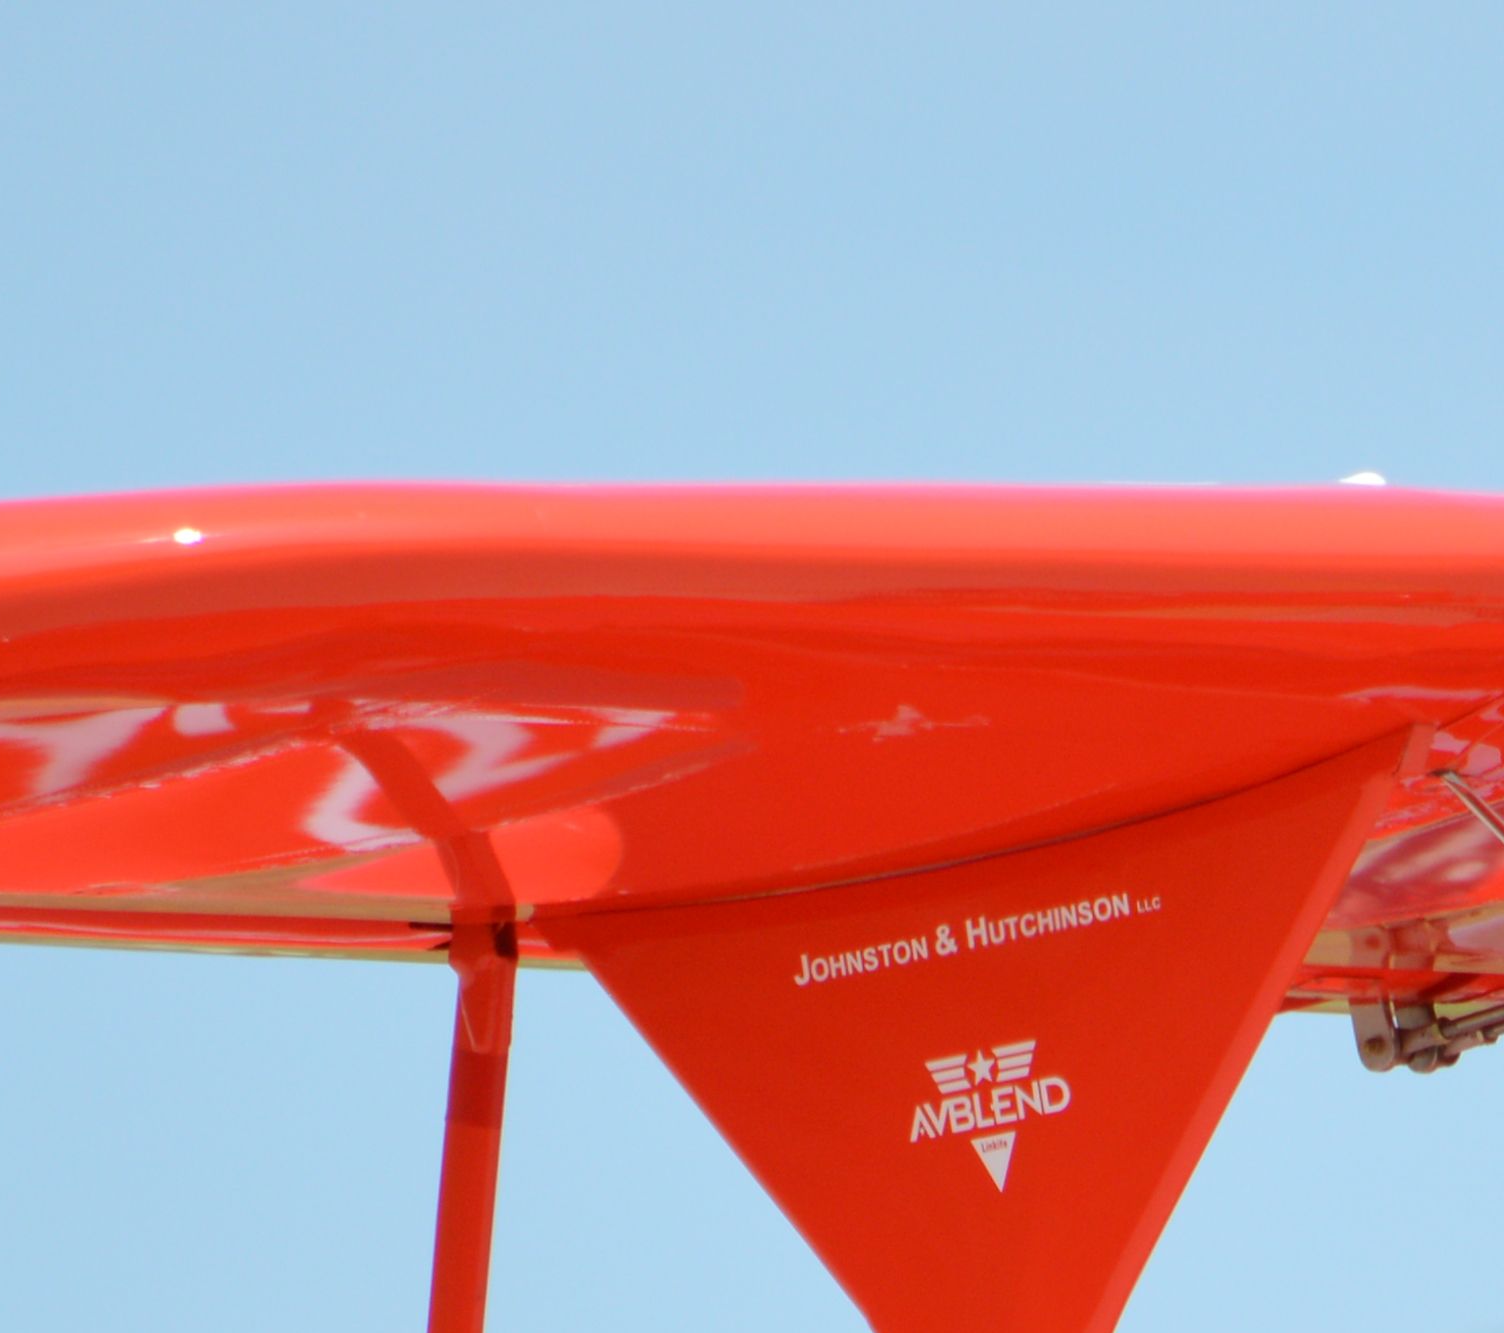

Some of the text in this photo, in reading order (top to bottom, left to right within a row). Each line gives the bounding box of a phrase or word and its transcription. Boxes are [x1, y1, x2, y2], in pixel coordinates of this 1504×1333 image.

[794, 893, 1161, 986] JOHNSTON & HUTCHINSON LLC
[909, 1075, 1072, 1143] AVBLEND
